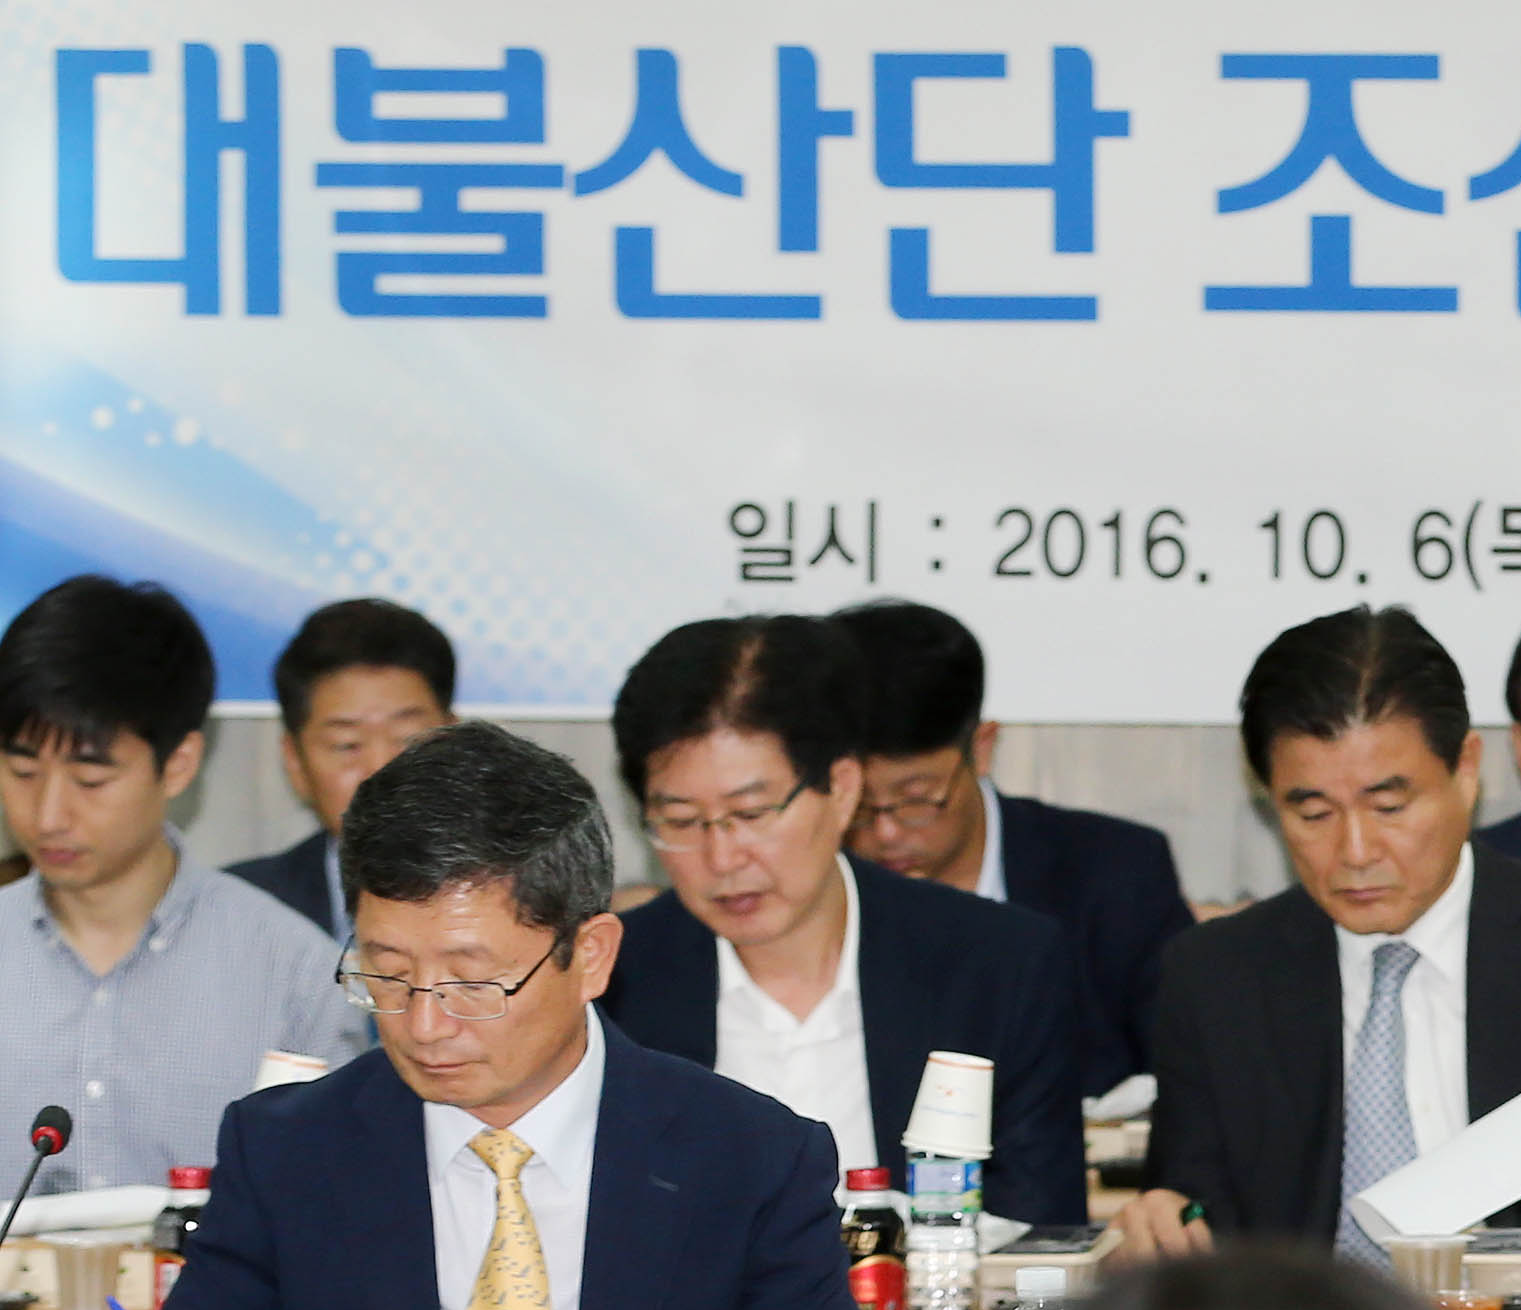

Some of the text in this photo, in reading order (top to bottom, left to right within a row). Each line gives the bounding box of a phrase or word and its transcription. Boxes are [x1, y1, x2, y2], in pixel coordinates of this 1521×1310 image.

[55, 43, 1130, 321] 대불산단
[729, 500, 877, 584] 일시
[995, 508, 1208, 583] 2016.
[1260, 510, 1367, 585] 10.
